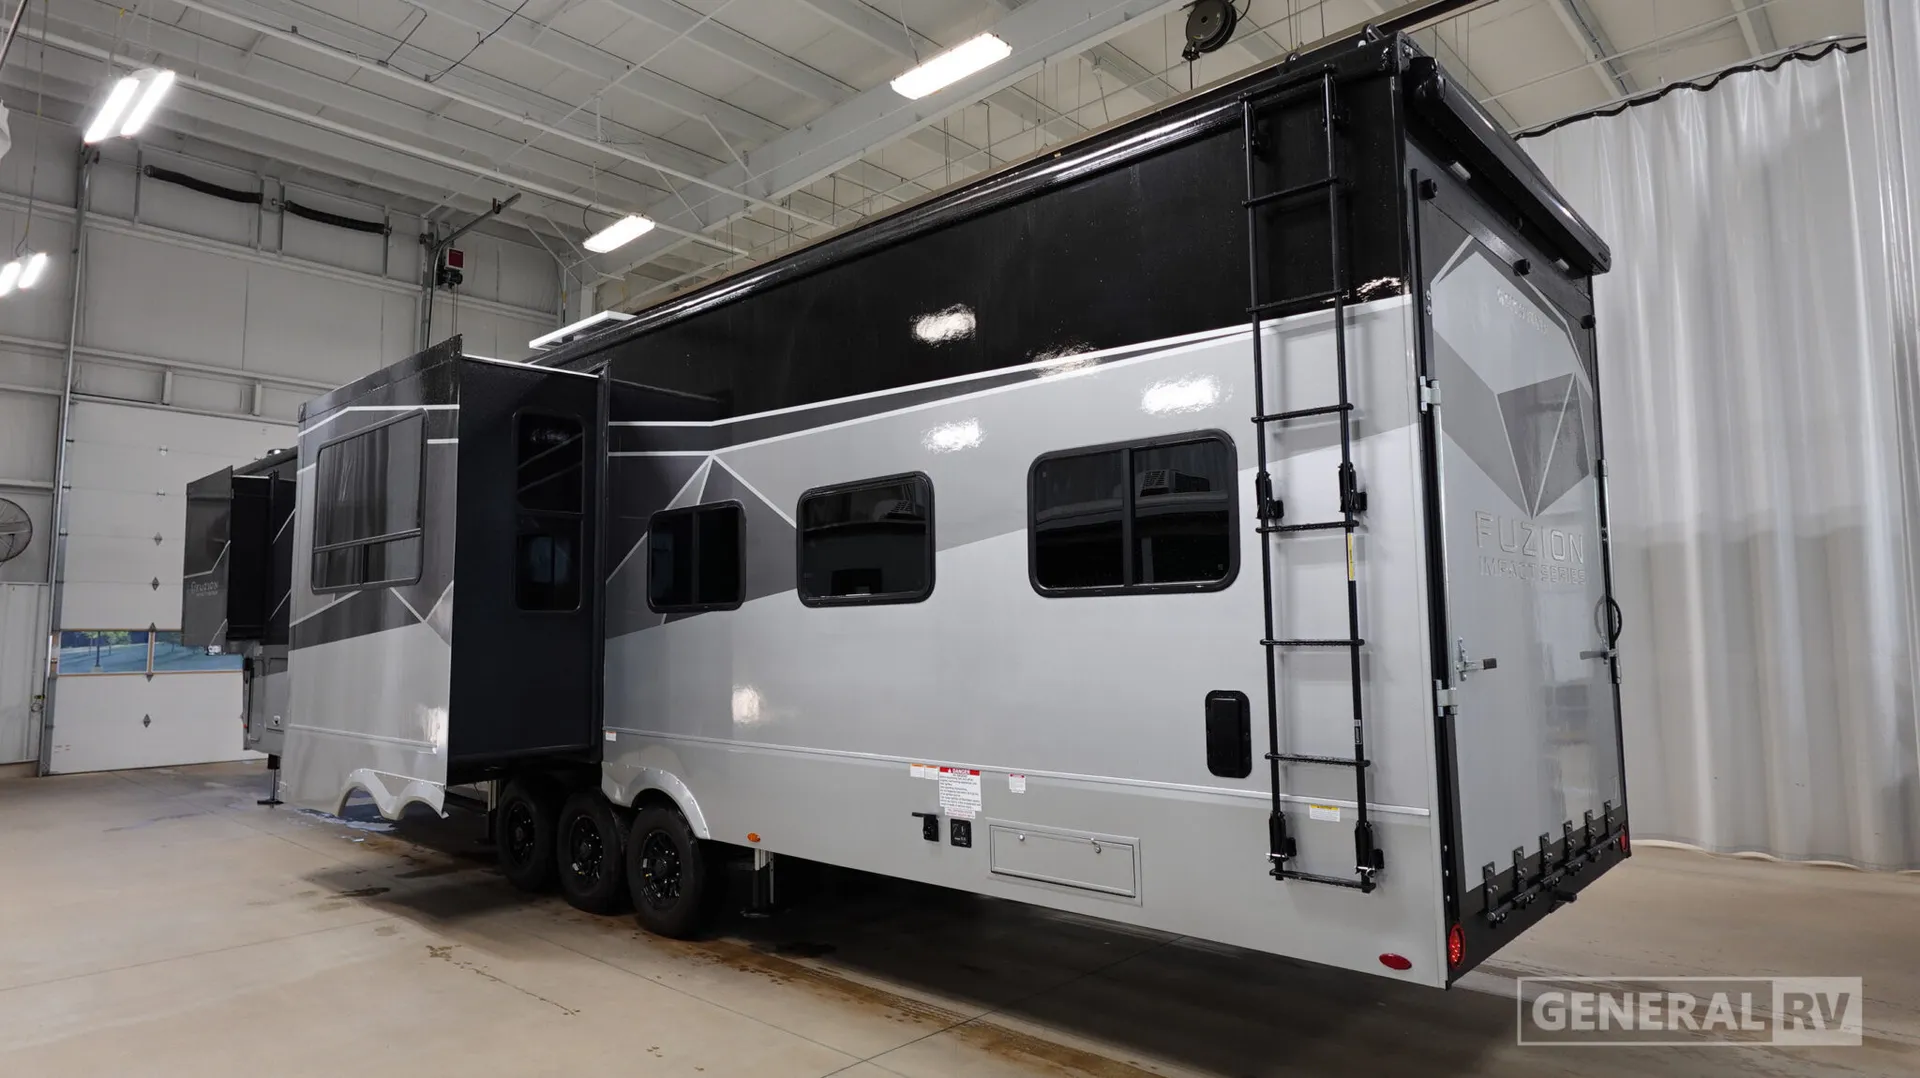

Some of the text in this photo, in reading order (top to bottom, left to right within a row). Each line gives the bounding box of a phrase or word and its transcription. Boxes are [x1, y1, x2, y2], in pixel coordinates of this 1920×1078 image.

[1475, 511, 1584, 564] FUZION
[1479, 556, 1586, 584] IMPACT SERIES
